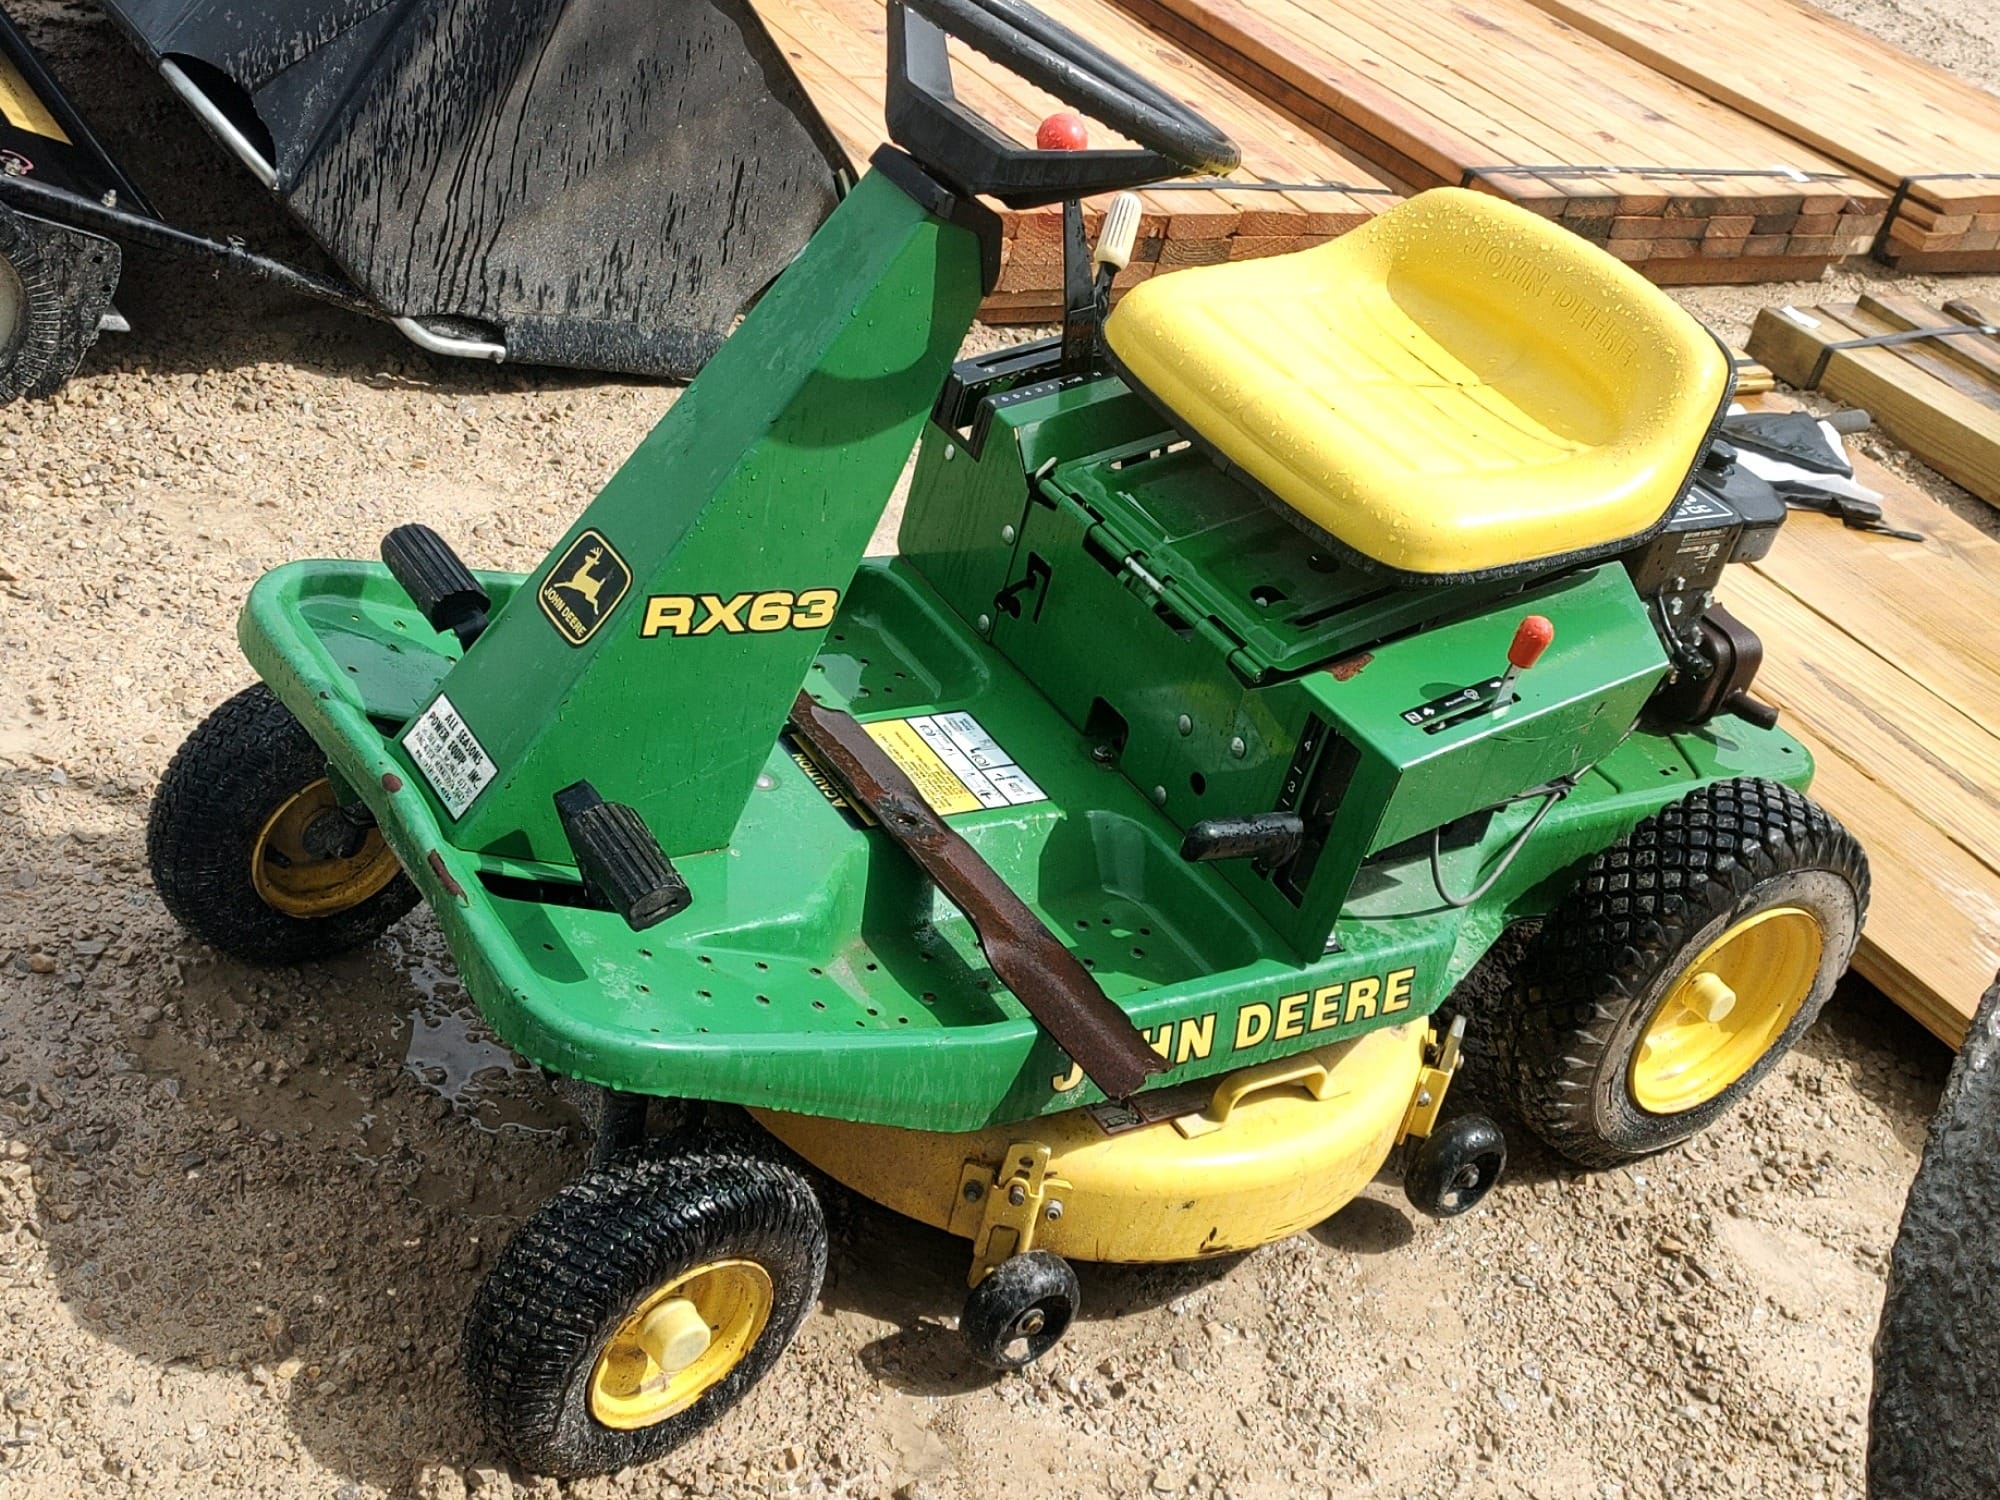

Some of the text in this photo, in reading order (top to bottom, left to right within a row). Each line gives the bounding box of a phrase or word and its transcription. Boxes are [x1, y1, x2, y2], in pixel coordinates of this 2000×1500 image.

[1463, 238, 1639, 367] JOHN DEERE
[543, 586, 587, 638] JOHN DEERE
[638, 588, 839, 639] RX63
[428, 711, 450, 744] POWER
[467, 768, 483, 790] INC.
[444, 713, 483, 766] ALL SEASONS
[791, 753, 838, 798] CAUTION
[1051, 966, 1416, 1092] JHN DEERE
